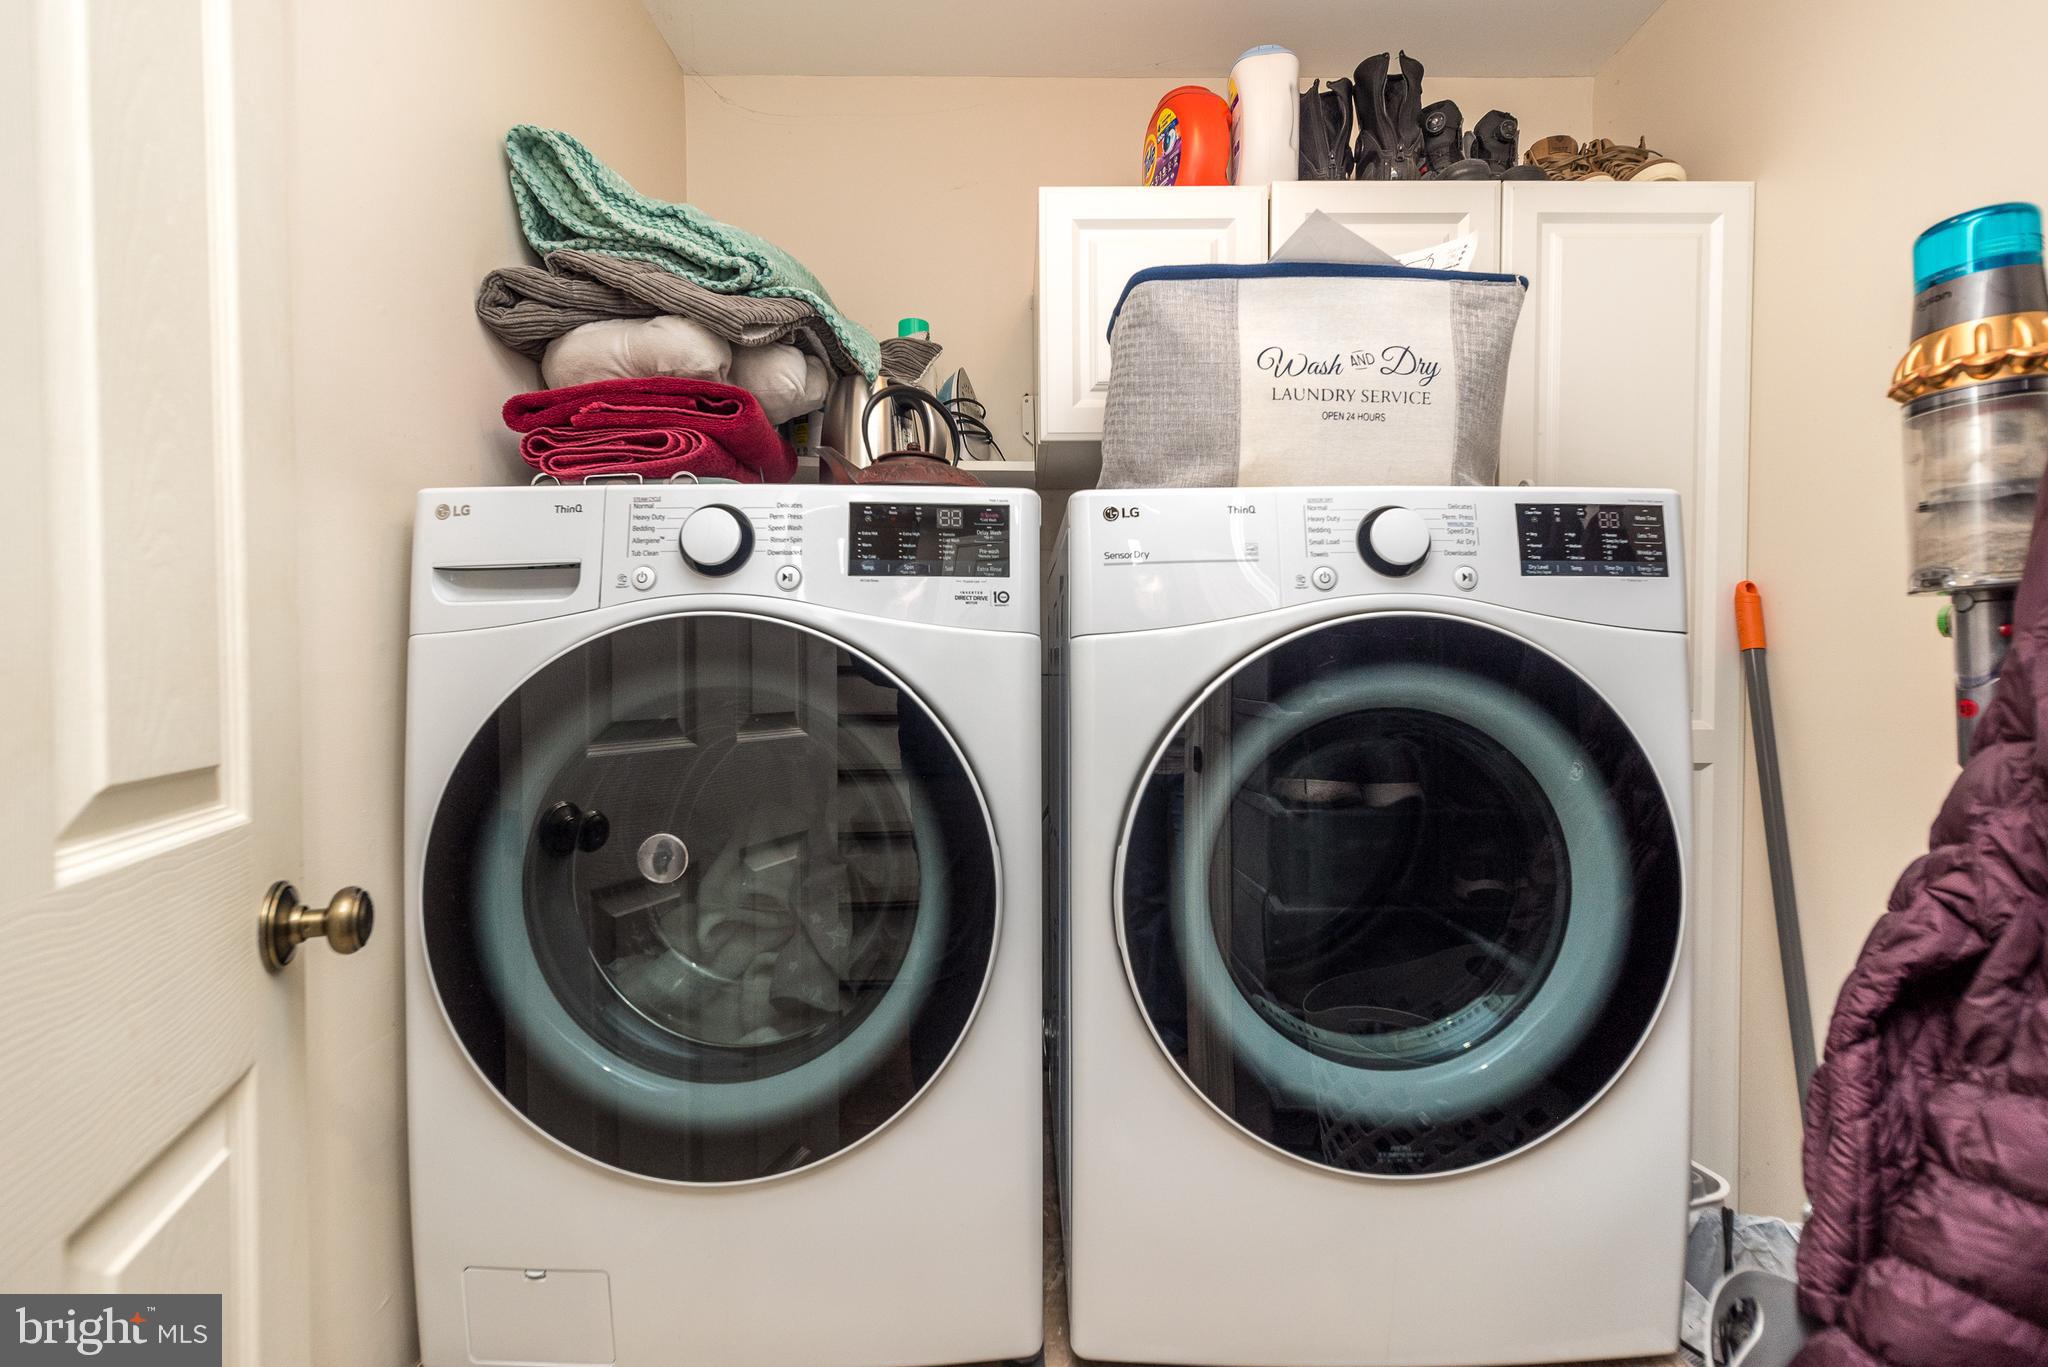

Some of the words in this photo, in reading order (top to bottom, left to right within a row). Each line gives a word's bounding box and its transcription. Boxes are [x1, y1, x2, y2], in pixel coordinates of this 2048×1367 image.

[1257, 347, 1344, 378] Wash
[1350, 352, 1375, 367] AND
[1380, 345, 1441, 387] Dry
[1272, 387, 1356, 402] LAUNDRY
[1361, 389, 1432, 405] SERVICE
[1322, 411, 1345, 422] OPEN
[1347, 412, 1356, 421] 24
[1358, 412, 1386, 422] HOURS
[453, 505, 470, 517] LG
[555, 503, 583, 514] ThinQ
[1122, 507, 1140, 518] LG
[1227, 505, 1256, 514] ThinQ
[632, 525, 656, 533] Bedding
[1465, 528, 1475, 536] Dry
[1104, 551, 1132, 560] Sensor
[1134, 551, 1150, 560] Dry
